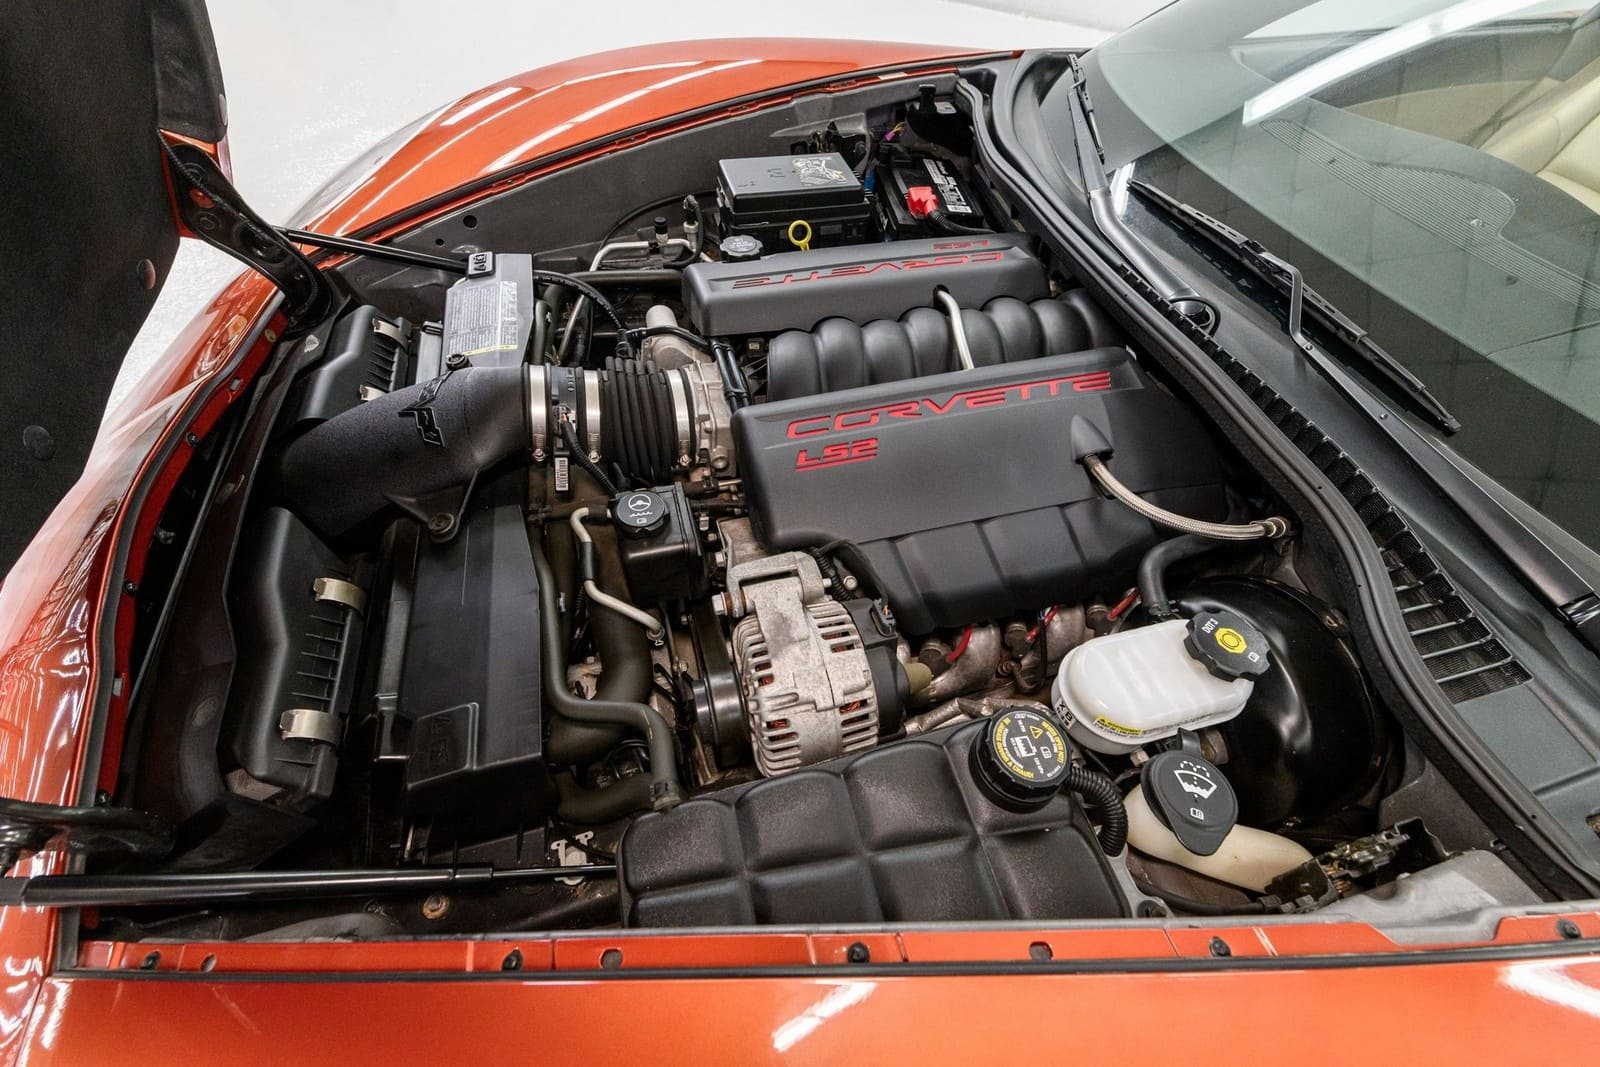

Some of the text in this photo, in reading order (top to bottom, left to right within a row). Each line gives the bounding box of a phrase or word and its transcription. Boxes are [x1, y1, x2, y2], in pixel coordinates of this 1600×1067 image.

[732, 252, 1004, 289] CORVETTE
[786, 371, 1111, 439] CORVETTE
[796, 437, 879, 466] LS2
[1201, 620, 1216, 634] DOT
